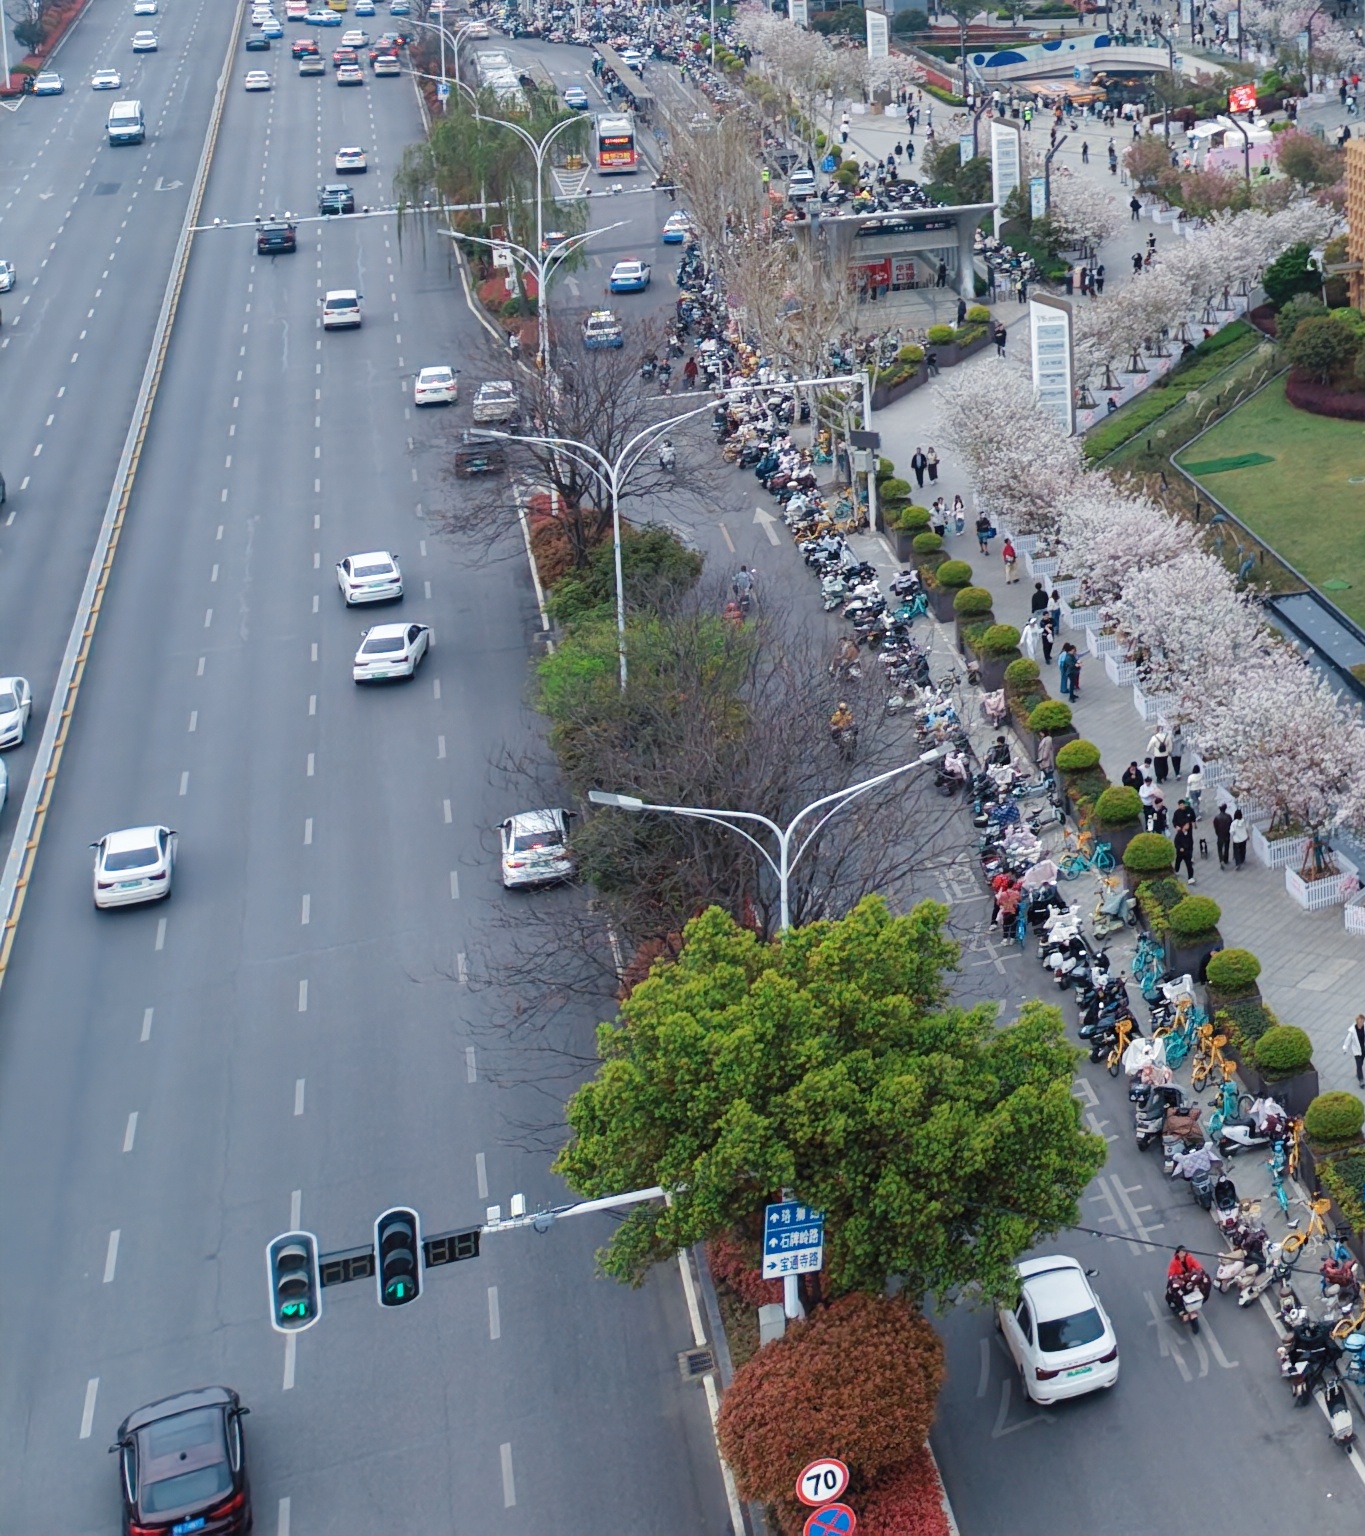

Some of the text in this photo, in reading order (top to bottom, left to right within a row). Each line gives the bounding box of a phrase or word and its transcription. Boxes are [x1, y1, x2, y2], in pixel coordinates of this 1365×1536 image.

[779, 1228, 819, 1249] 石牌岭路
[779, 1251, 819, 1272] 宝通寺路
[806, 1468, 837, 1497] 70
